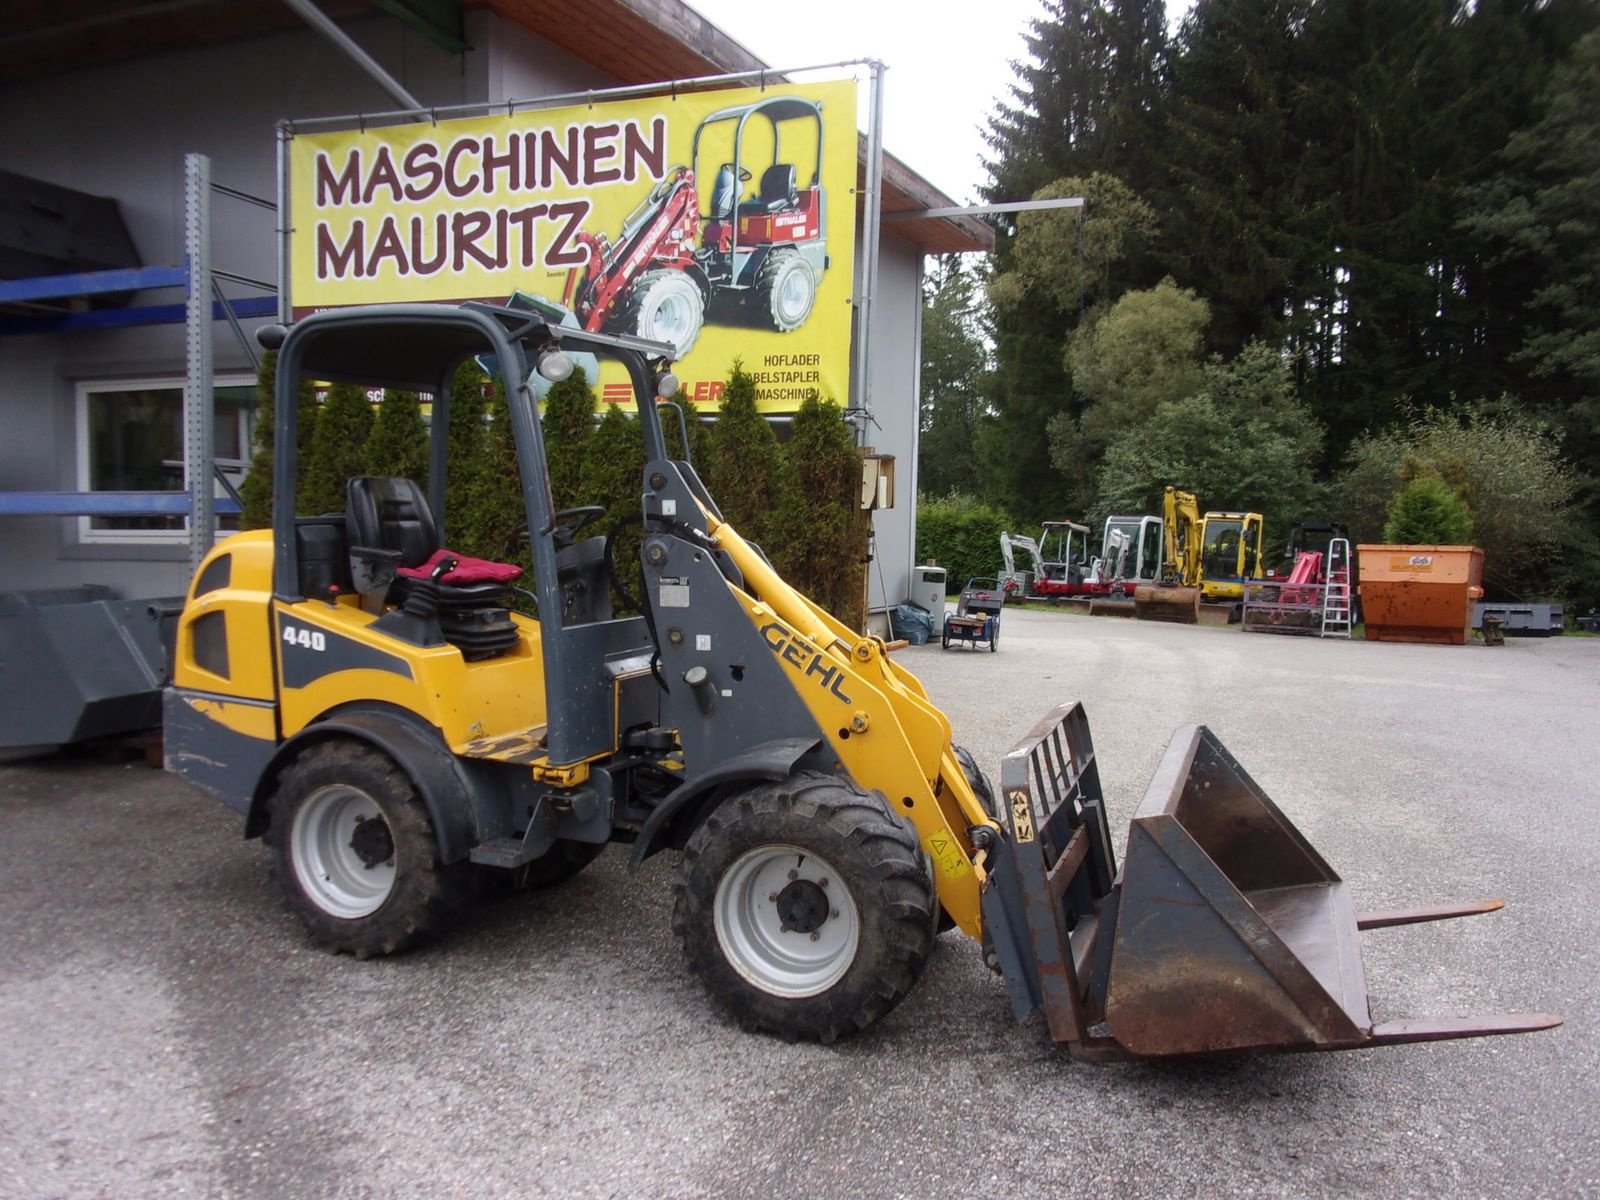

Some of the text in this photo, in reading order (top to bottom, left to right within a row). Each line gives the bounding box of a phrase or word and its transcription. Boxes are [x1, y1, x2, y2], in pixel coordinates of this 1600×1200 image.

[316, 118, 665, 207] MASCHINEN
[316, 200, 590, 279] MAURITZ
[764, 354, 820, 367] HOFLADER
[747, 371, 819, 383] ABELSTAPLER
[755, 388, 819, 400] MASCHINEN
[283, 626, 326, 651] 440
[760, 622, 851, 704] GEHL
